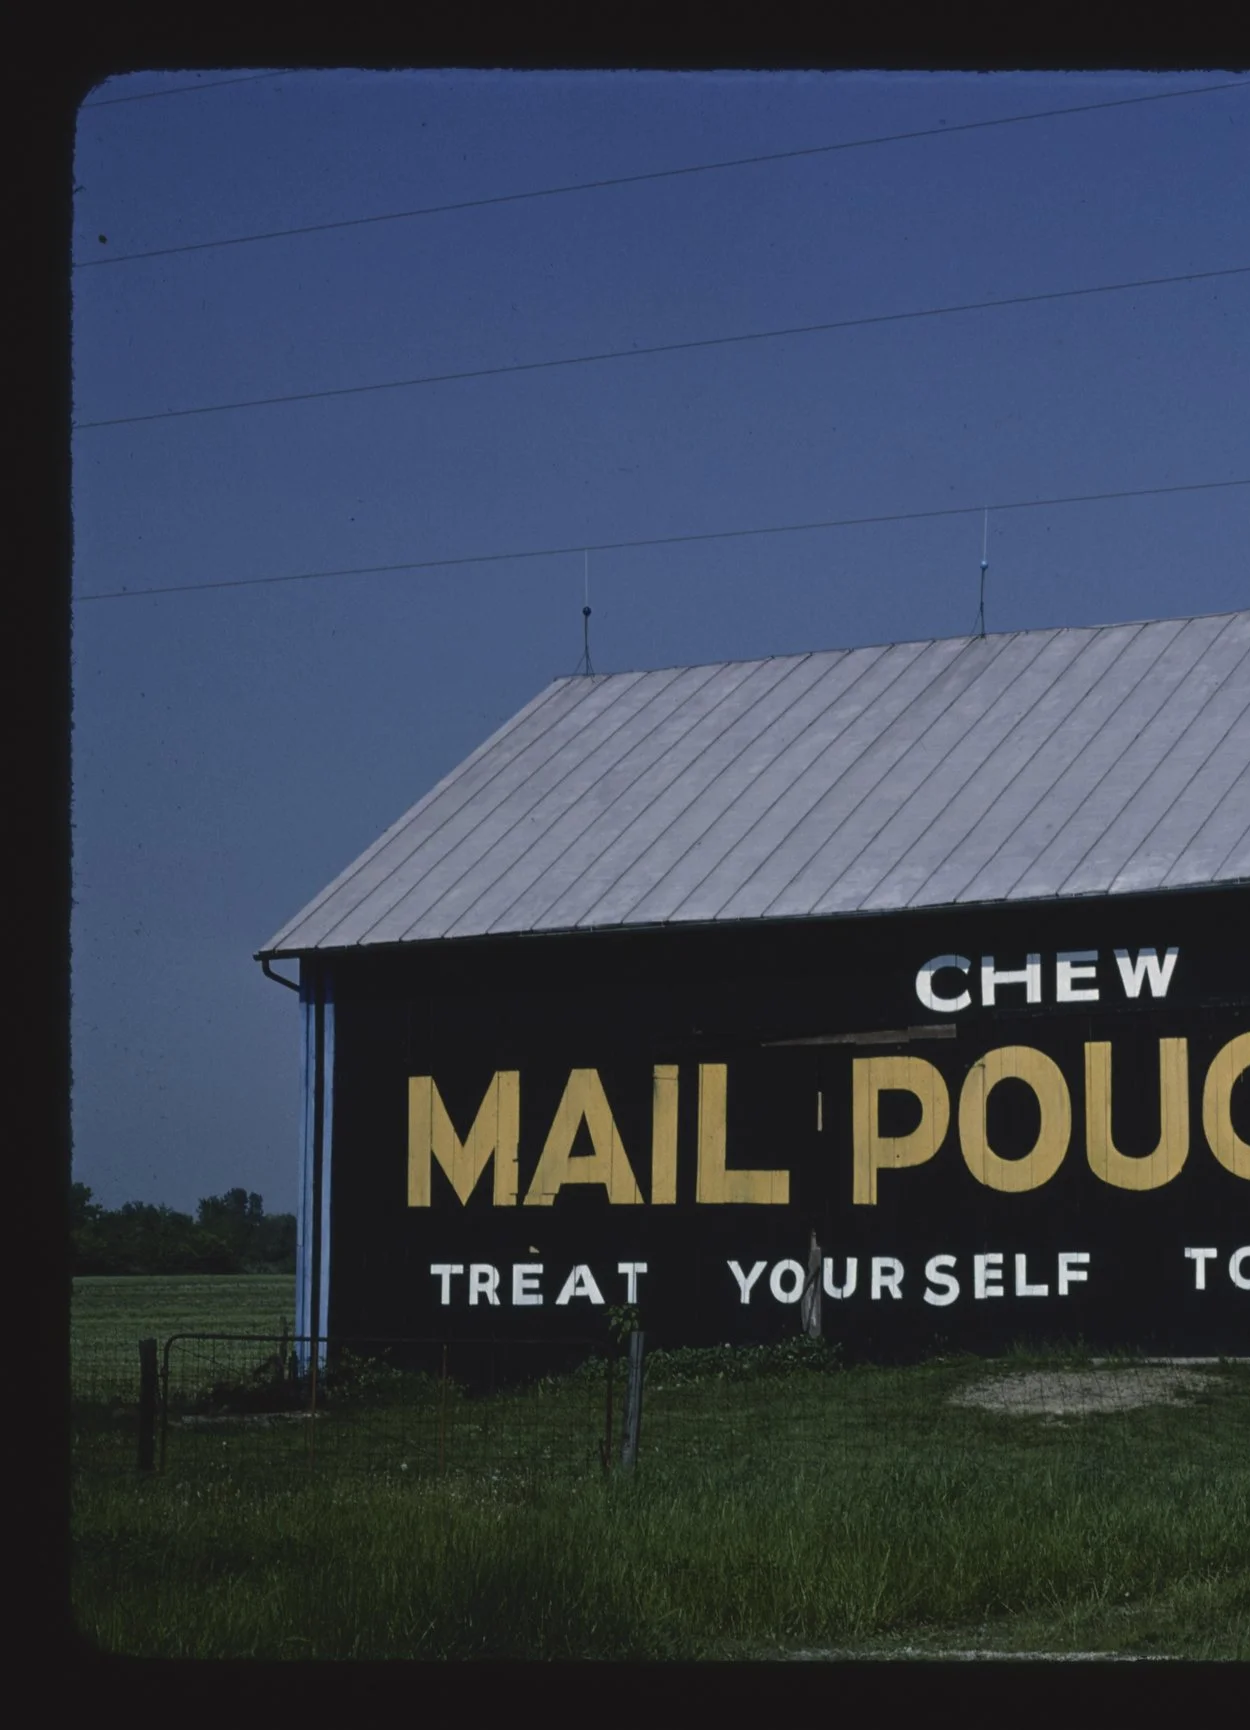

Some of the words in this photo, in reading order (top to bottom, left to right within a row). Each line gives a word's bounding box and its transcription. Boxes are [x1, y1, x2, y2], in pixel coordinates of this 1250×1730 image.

[915, 947, 1179, 1013] CHEW
[407, 1063, 790, 1207] MAIL
[430, 1261, 648, 1306] TREAT
[726, 1252, 1091, 1307] YOURSELF
